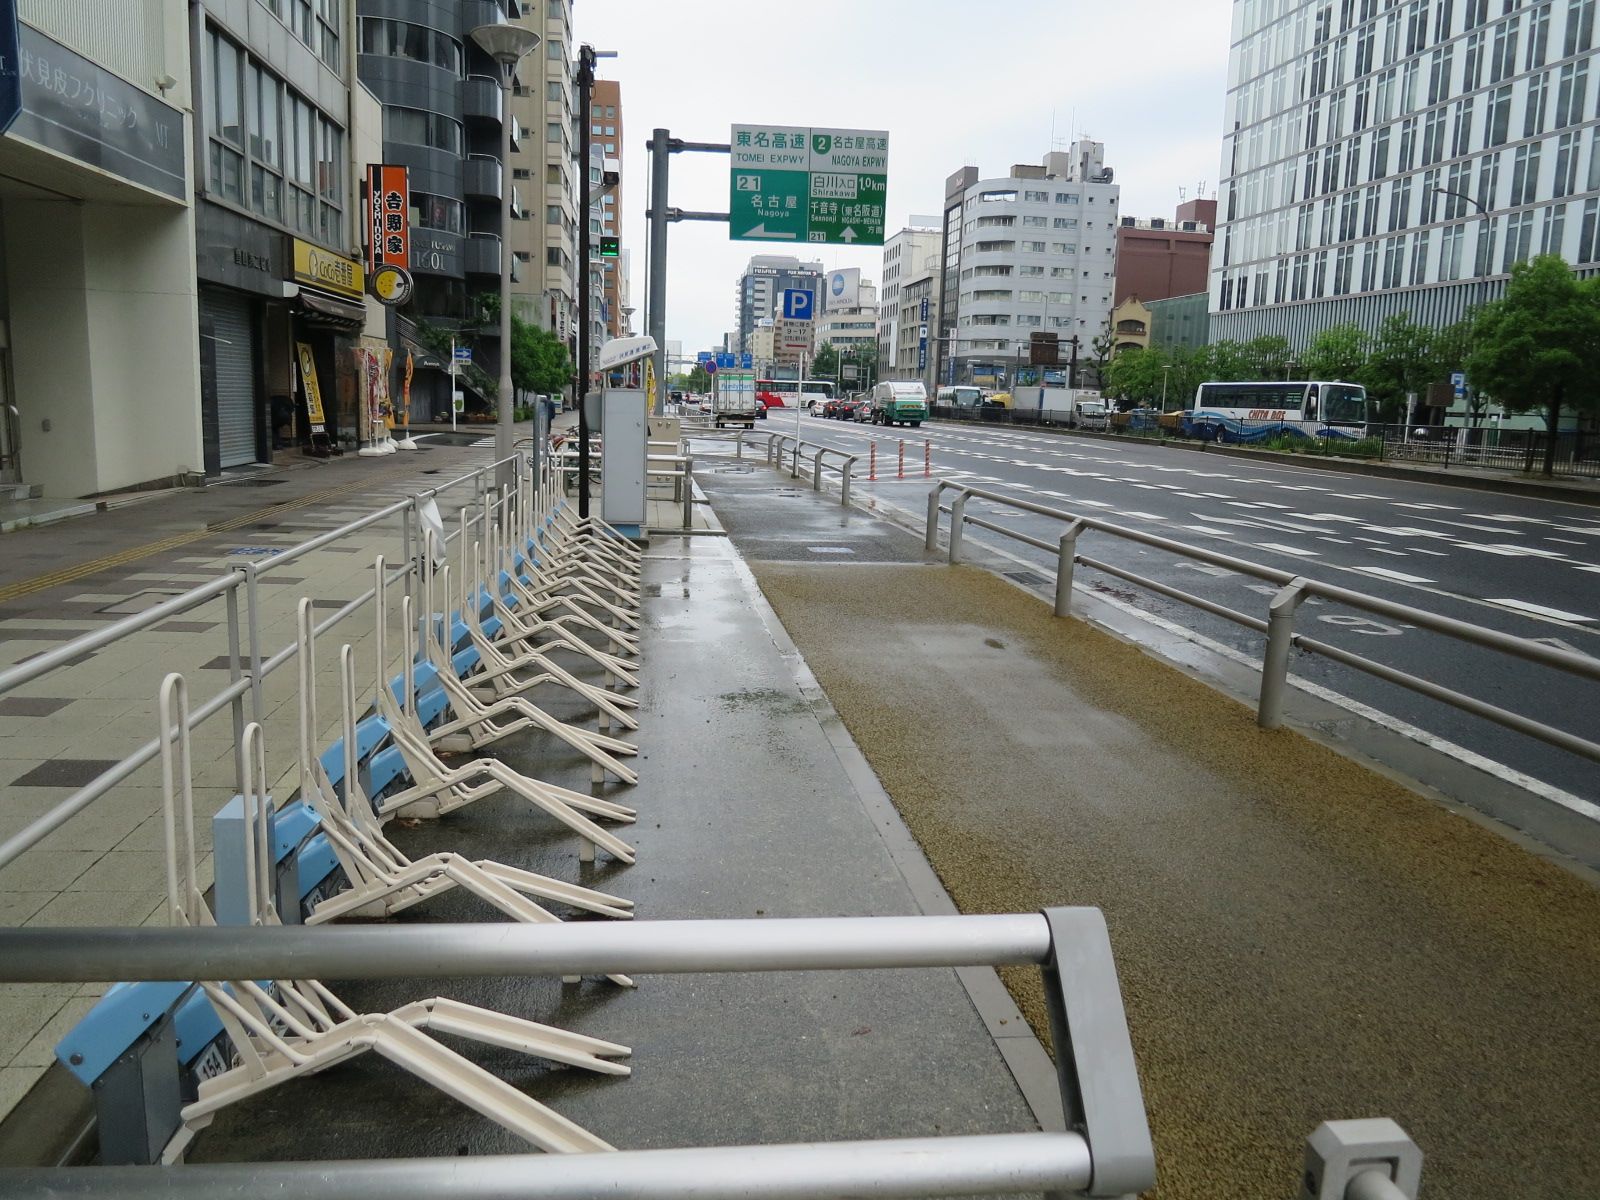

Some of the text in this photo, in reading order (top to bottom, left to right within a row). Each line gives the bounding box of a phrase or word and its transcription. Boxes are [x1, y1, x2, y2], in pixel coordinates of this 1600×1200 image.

[736, 131, 806, 150] 東名高速
[818, 137, 826, 150] 2
[833, 136, 887, 151] 名古屋高速
[736, 152, 805, 164] TOMEI EXPWY
[831, 154, 886, 168] NAGOYA EXPWY
[738, 176, 759, 190] 21
[813, 175, 856, 189] 白川入口
[812, 188, 856, 198] Shirakawa
[751, 194, 797, 209] 名古屋
[810, 201, 838, 215] 千音寺
[757, 208, 790, 218] Nagoya
[385, 192, 404, 255] 吉野家
[867, 226, 883, 235] 方面
[810, 232, 825, 241] 211
[790, 291, 808, 317] P
[1248, 409, 1269, 420] CHITA
[202, 1051, 222, 1079] 154
